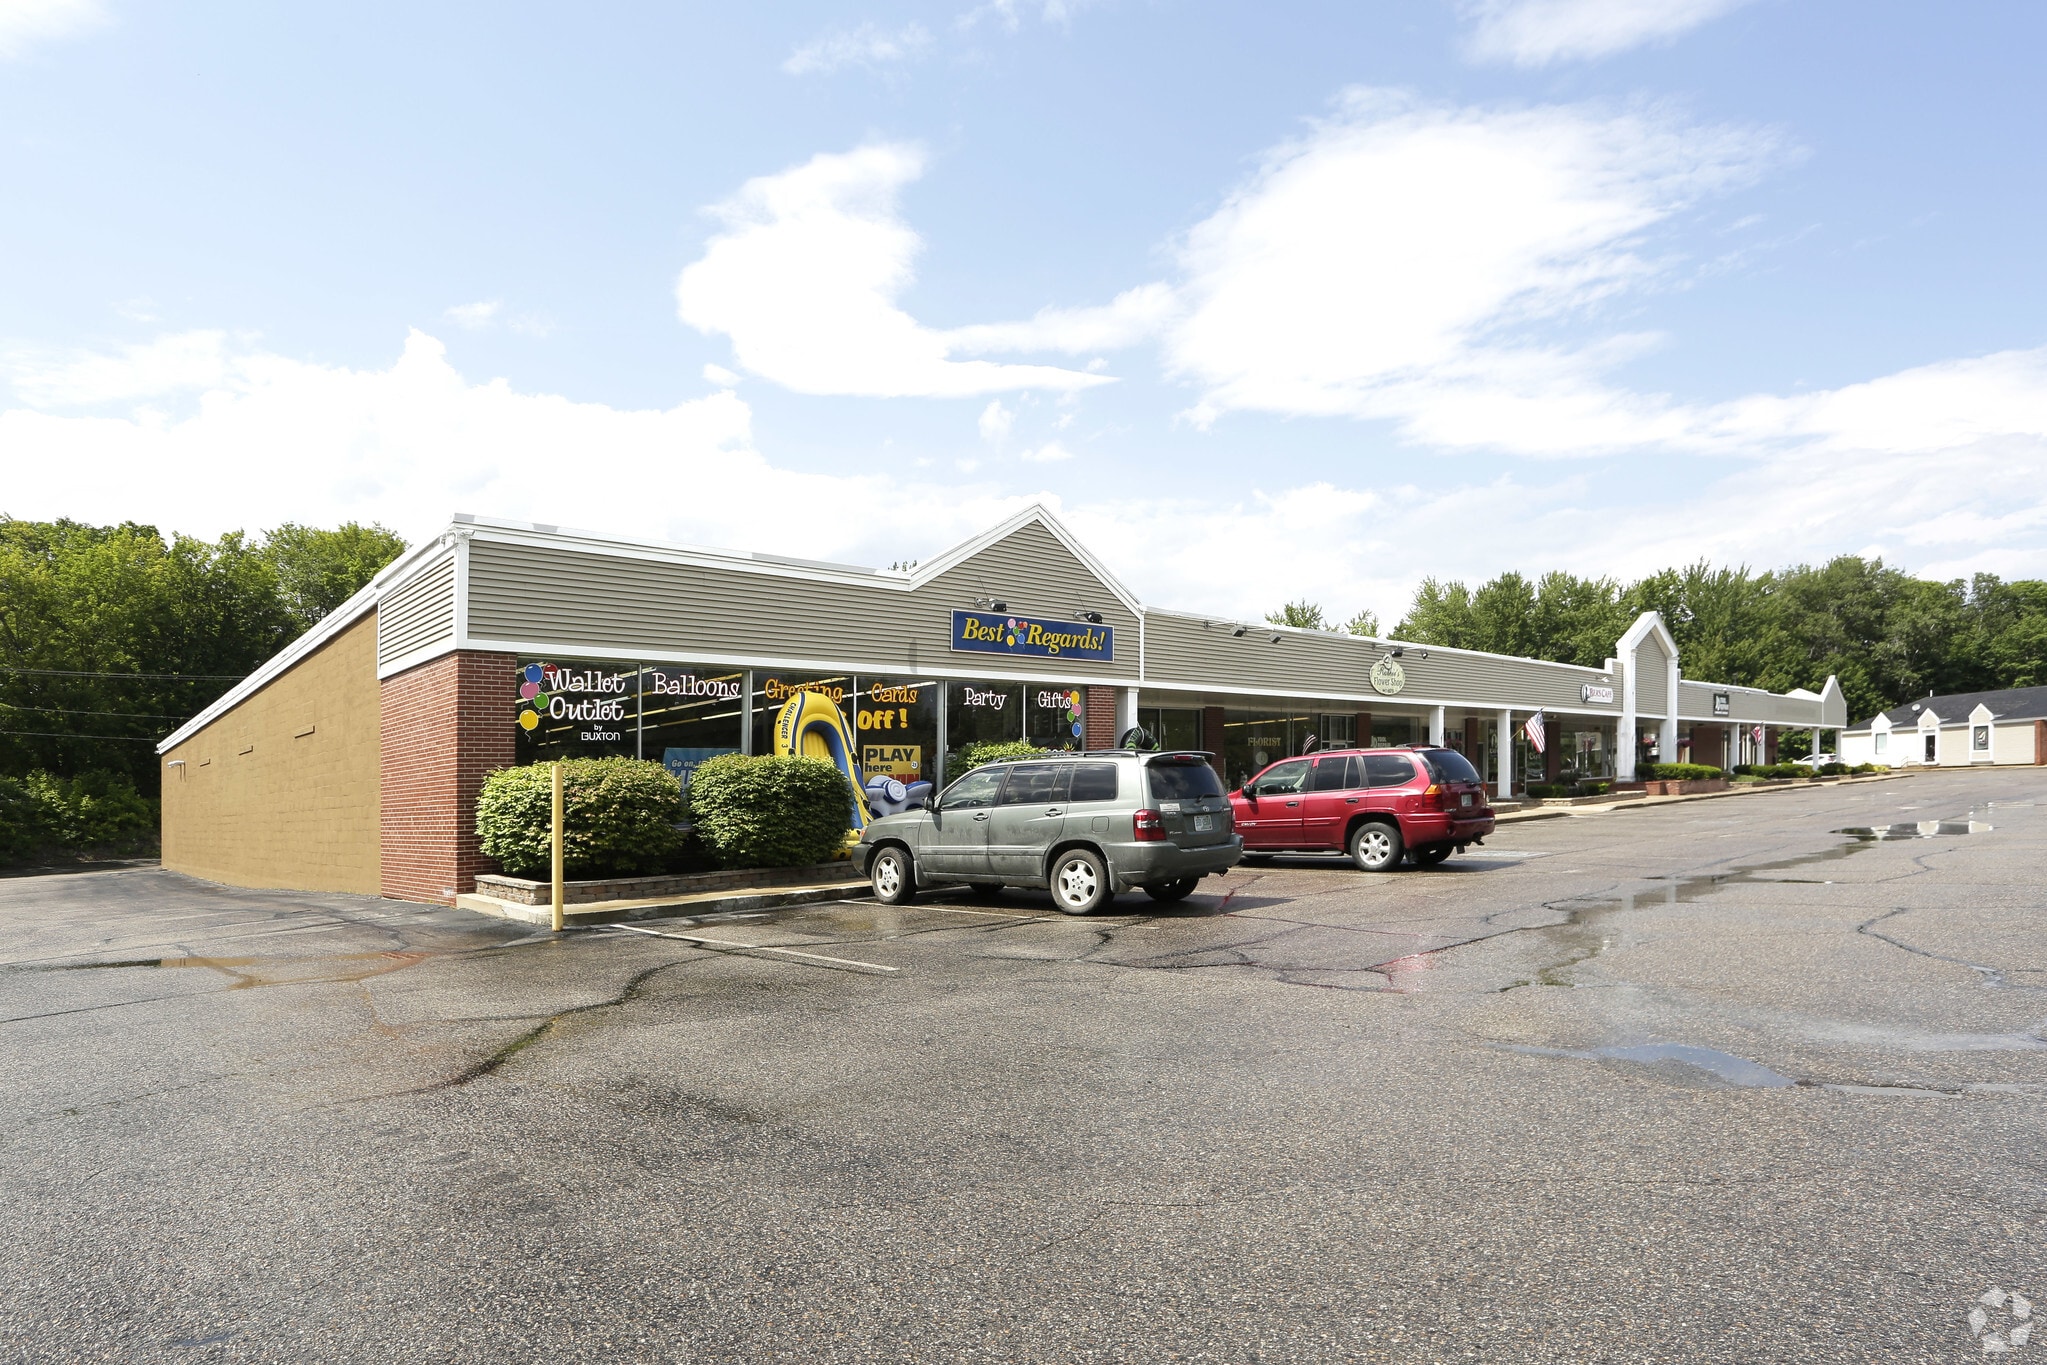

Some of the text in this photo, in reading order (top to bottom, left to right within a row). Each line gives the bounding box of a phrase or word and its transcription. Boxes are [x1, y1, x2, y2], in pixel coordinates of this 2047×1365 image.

[962, 617, 1106, 654] Best Regards!
[545, 668, 626, 693] Wallet
[652, 672, 740, 698] Balloons
[871, 683, 918, 703] Cards
[963, 687, 1007, 710] Party
[1038, 691, 1072, 709] Gifts
[549, 696, 625, 721] Outlet
[781, 702, 796, 739] CHALLENGER
[581, 732, 621, 741] BUXTON
[1247, 736, 1281, 746] FLORIST
[671, 759, 682, 767] Go
[865, 748, 915, 762] PLAY
[864, 762, 892, 772] here
